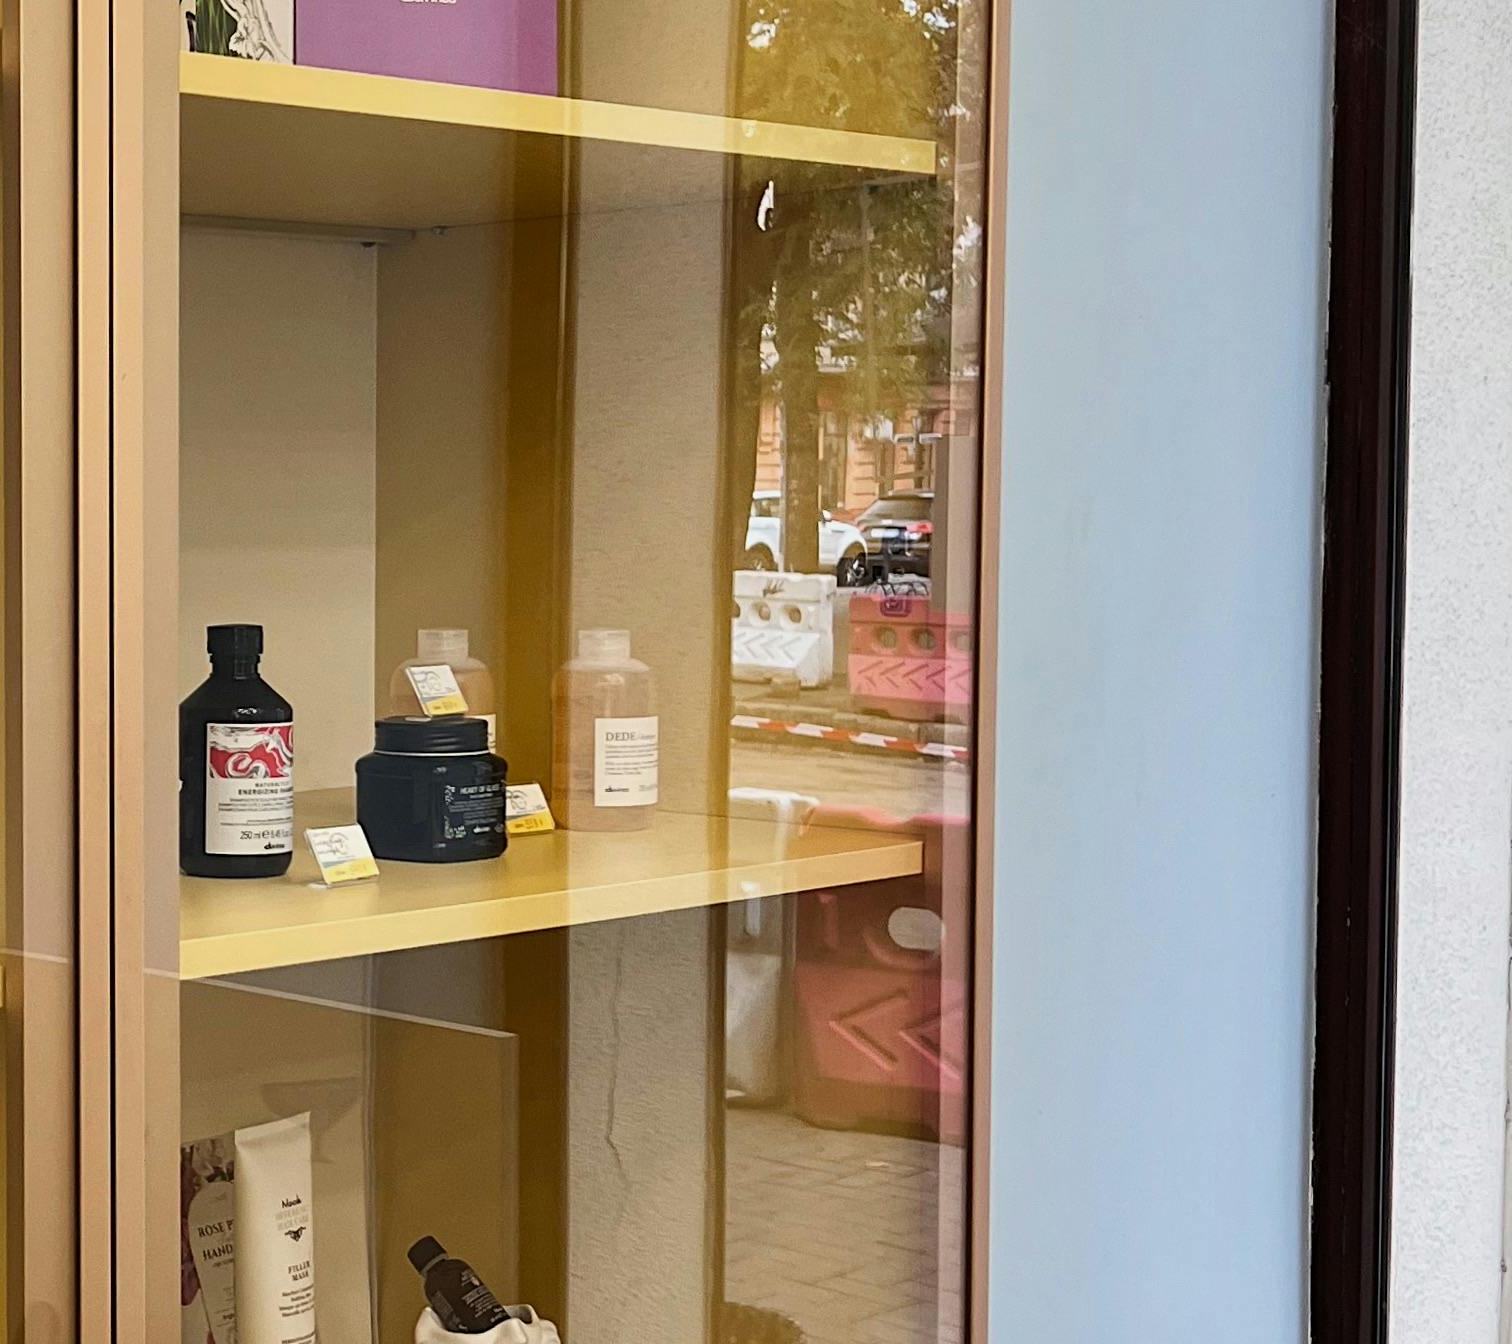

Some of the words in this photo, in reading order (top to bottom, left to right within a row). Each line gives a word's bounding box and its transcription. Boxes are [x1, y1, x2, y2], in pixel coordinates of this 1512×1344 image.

[605, 731, 637, 742] DEDE
[197, 1222, 226, 1238] ROSE
[202, 1242, 234, 1261] HAND
